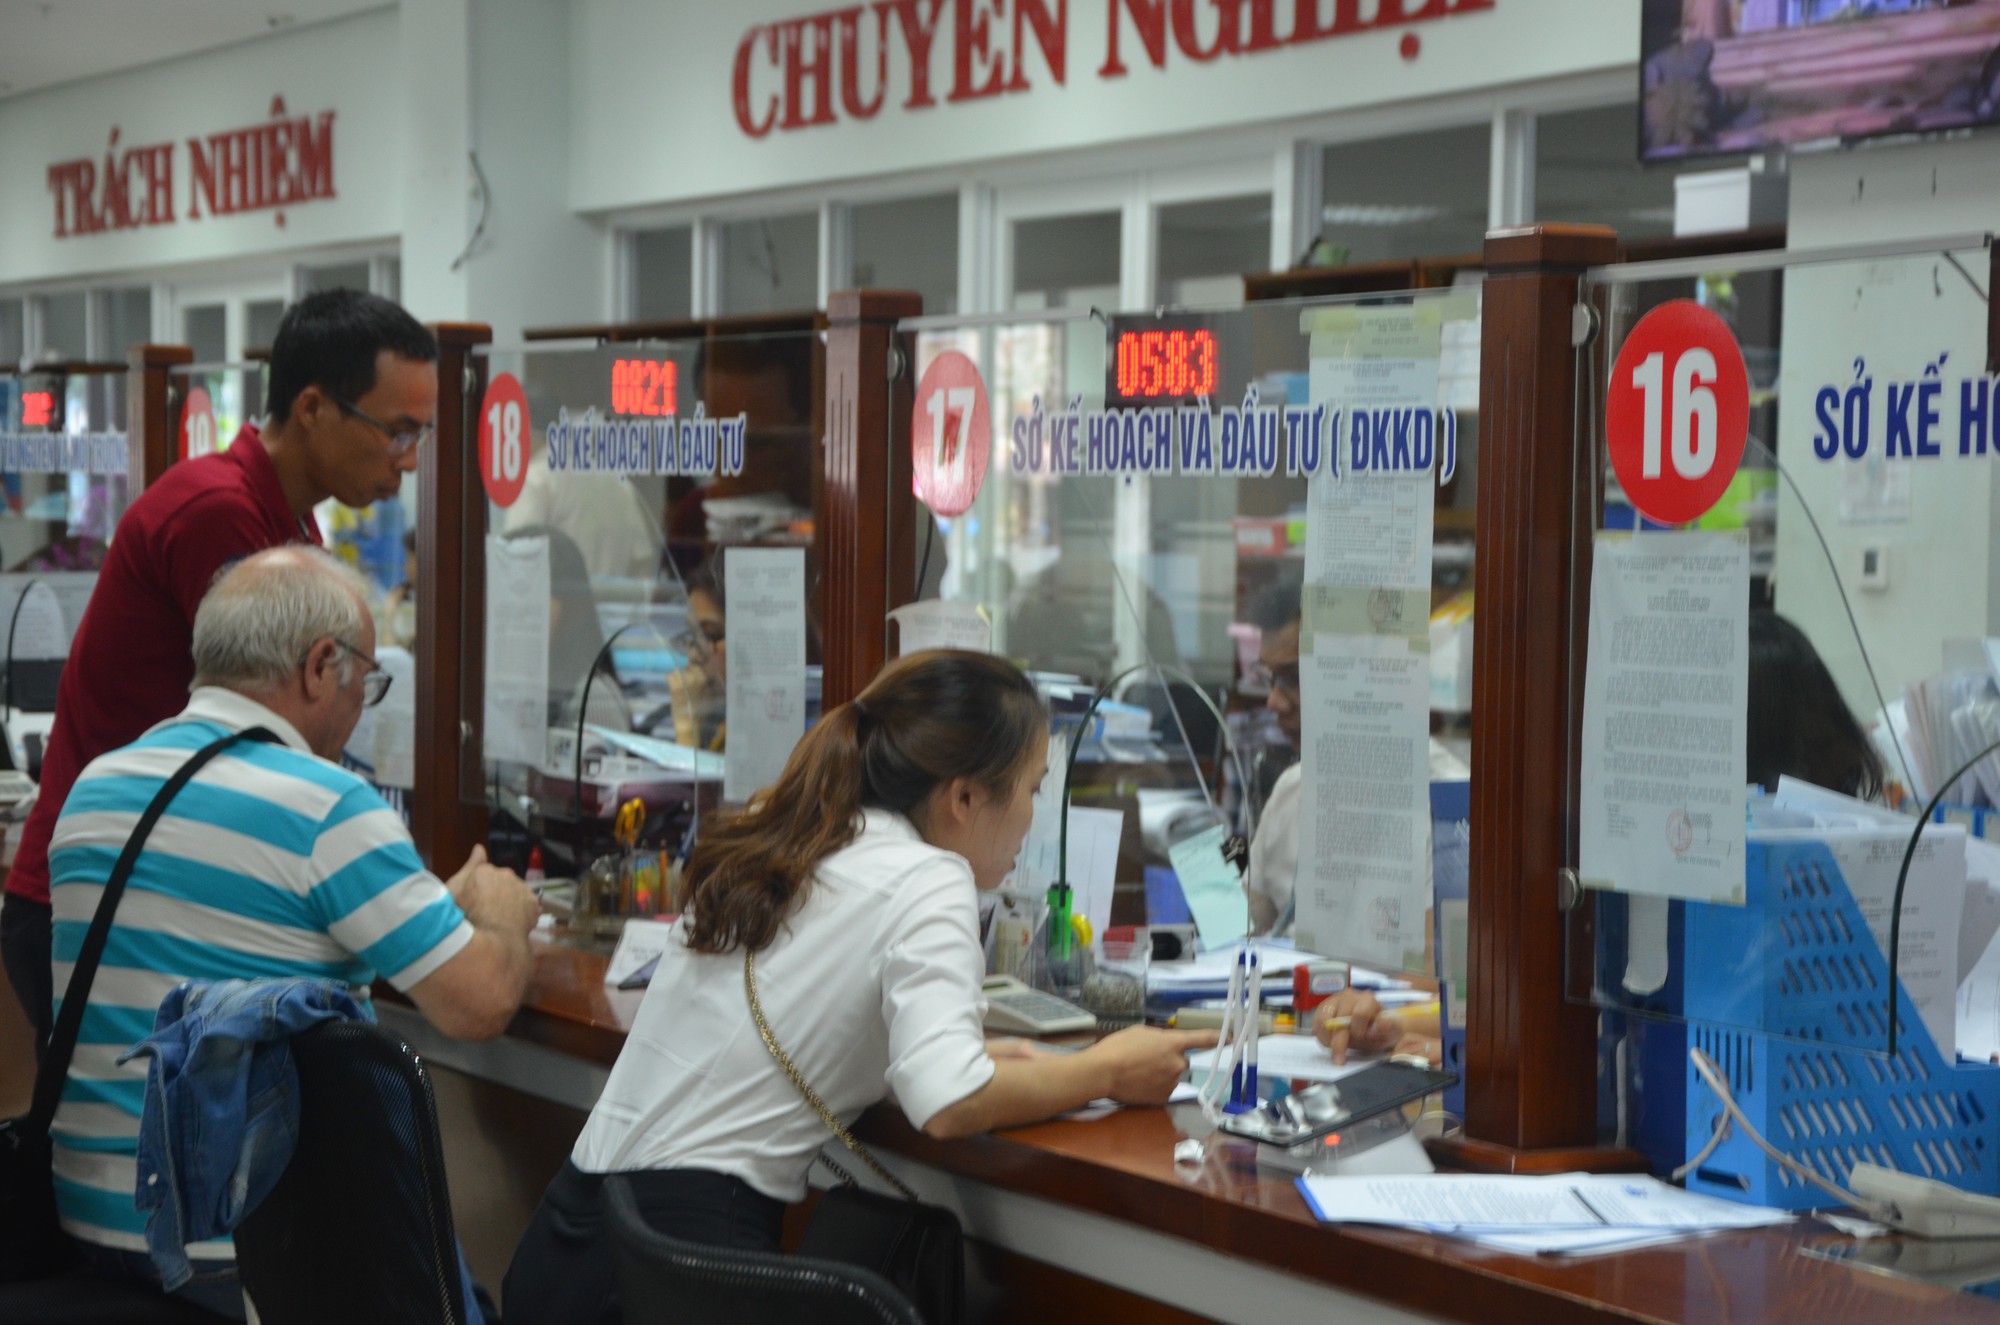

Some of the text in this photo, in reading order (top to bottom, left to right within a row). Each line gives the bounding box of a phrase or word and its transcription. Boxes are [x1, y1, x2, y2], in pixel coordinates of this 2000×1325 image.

[48, 95, 336, 238] TRÁCH NHIỆM
[1117, 330, 1214, 397] 0583
[1814, 356, 1872, 459] SỞ
[1886, 351, 1949, 457] KẾ
[488, 401, 522, 481] 18
[548, 407, 569, 470] SỞ
[573, 407, 597, 470] KẾ
[597, 422, 650, 481] HOẠCH
[654, 412, 676, 471] VÀ
[721, 413, 746, 472] TƯ
[927, 388, 975, 483] 17
[1013, 394, 1044, 472] SỞ
[1051, 393, 1083, 472] KẾ
[1088, 411, 1170, 485] HOẠCH
[1180, 395, 1212, 471] VÀ
[1222, 387, 1276, 471] ĐẦU
[1286, 405, 1324, 471] TƯ
[1632, 348, 1717, 480] 16
